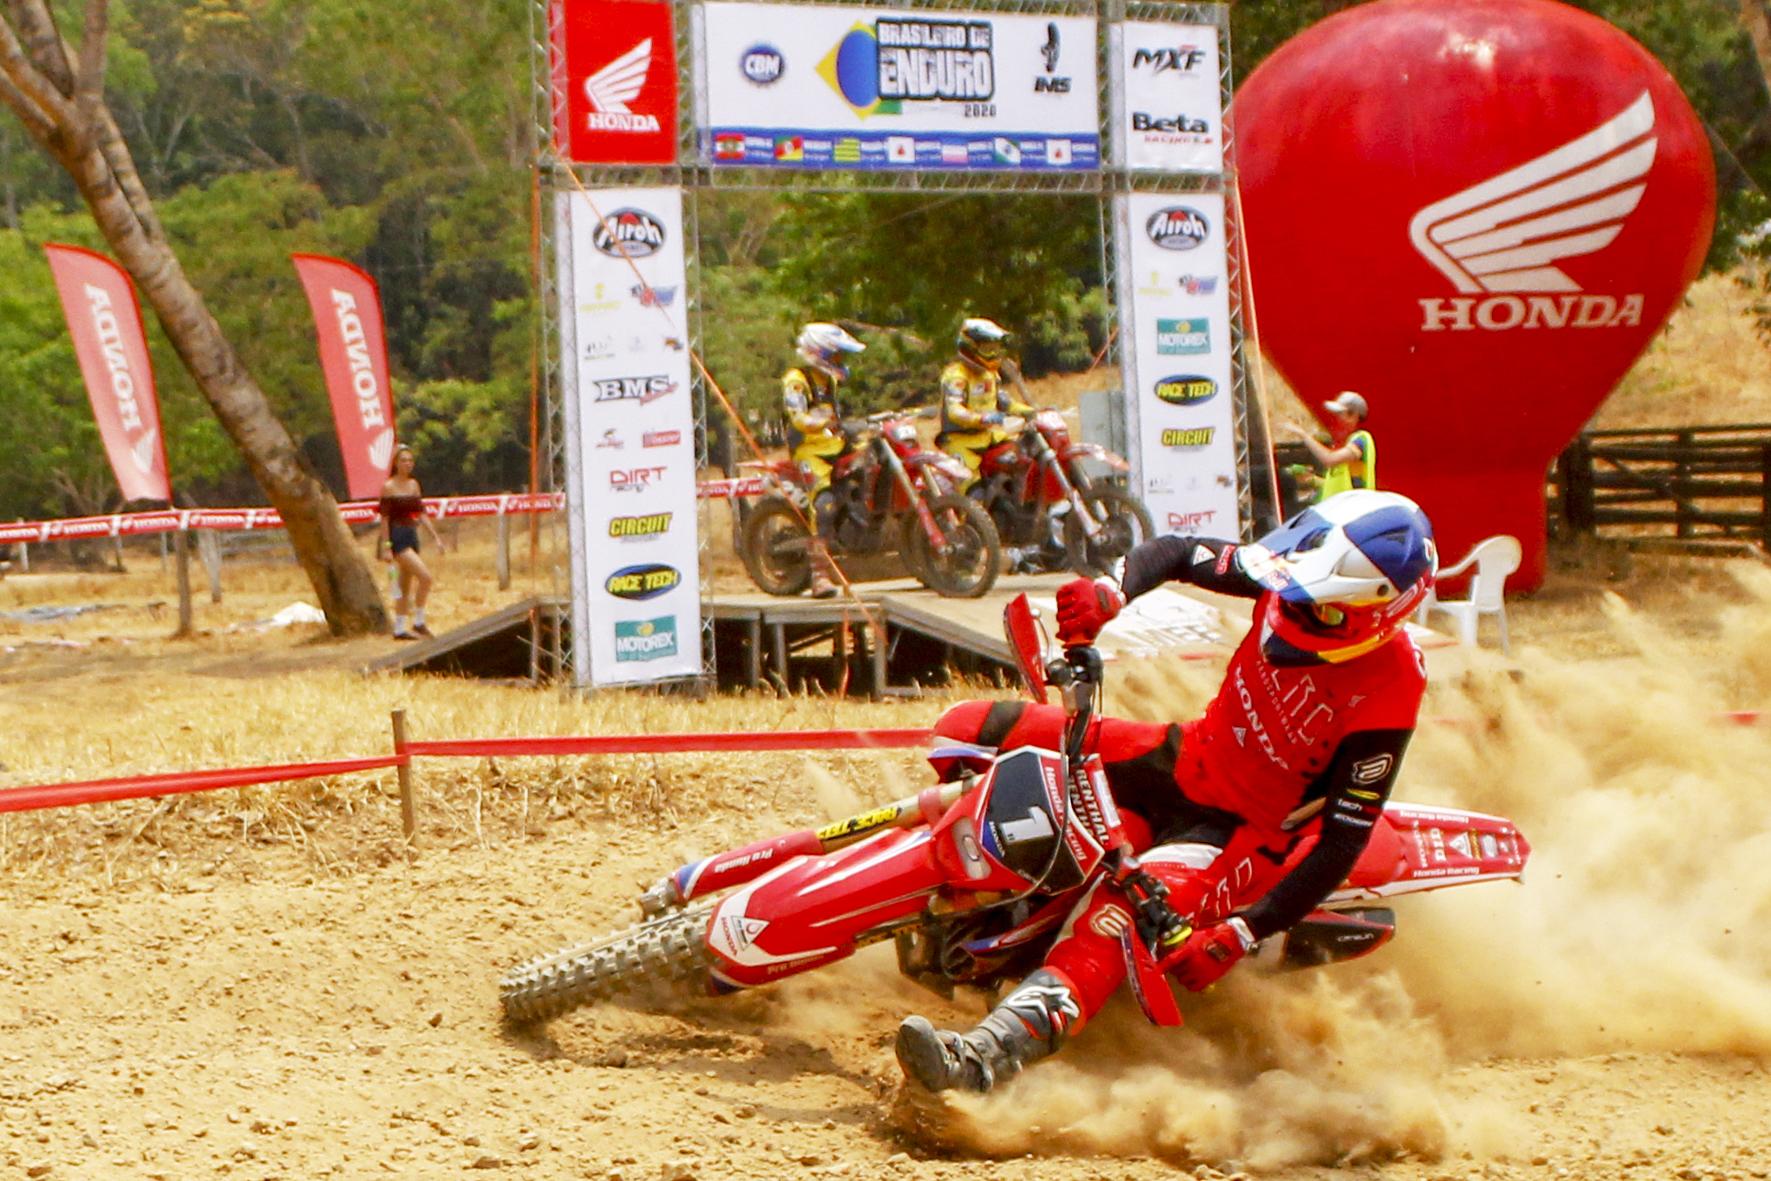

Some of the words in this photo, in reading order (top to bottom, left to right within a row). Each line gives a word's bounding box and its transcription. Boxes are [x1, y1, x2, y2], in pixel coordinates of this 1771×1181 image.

[968, 26, 990, 48] DE
[744, 53, 781, 76] CBM
[1132, 47, 1206, 74] MXF
[879, 47, 993, 97] ENDURO
[1034, 76, 1072, 93] IMS
[588, 112, 661, 132] HONDA
[963, 104, 997, 118] 2020
[1132, 111, 1209, 133] Beta
[598, 214, 663, 249] Airoh
[1151, 210, 1206, 237] Airoh
[1418, 293, 1645, 331] HONDA
[597, 376, 671, 401] BMS
[1161, 427, 1215, 447] CIRCUIT
[609, 466, 668, 486] DIRT
[608, 512, 674, 538] CIRCUIT
[1167, 511, 1217, 528] DIRT
[608, 574, 644, 592] RACE
[645, 570, 679, 590] TECH
[616, 632, 674, 653] MOTOREX
[1075, 769, 1110, 842] RENTHAL
[1000, 805, 1054, 844] 1
[751, 848, 773, 862] Pro
